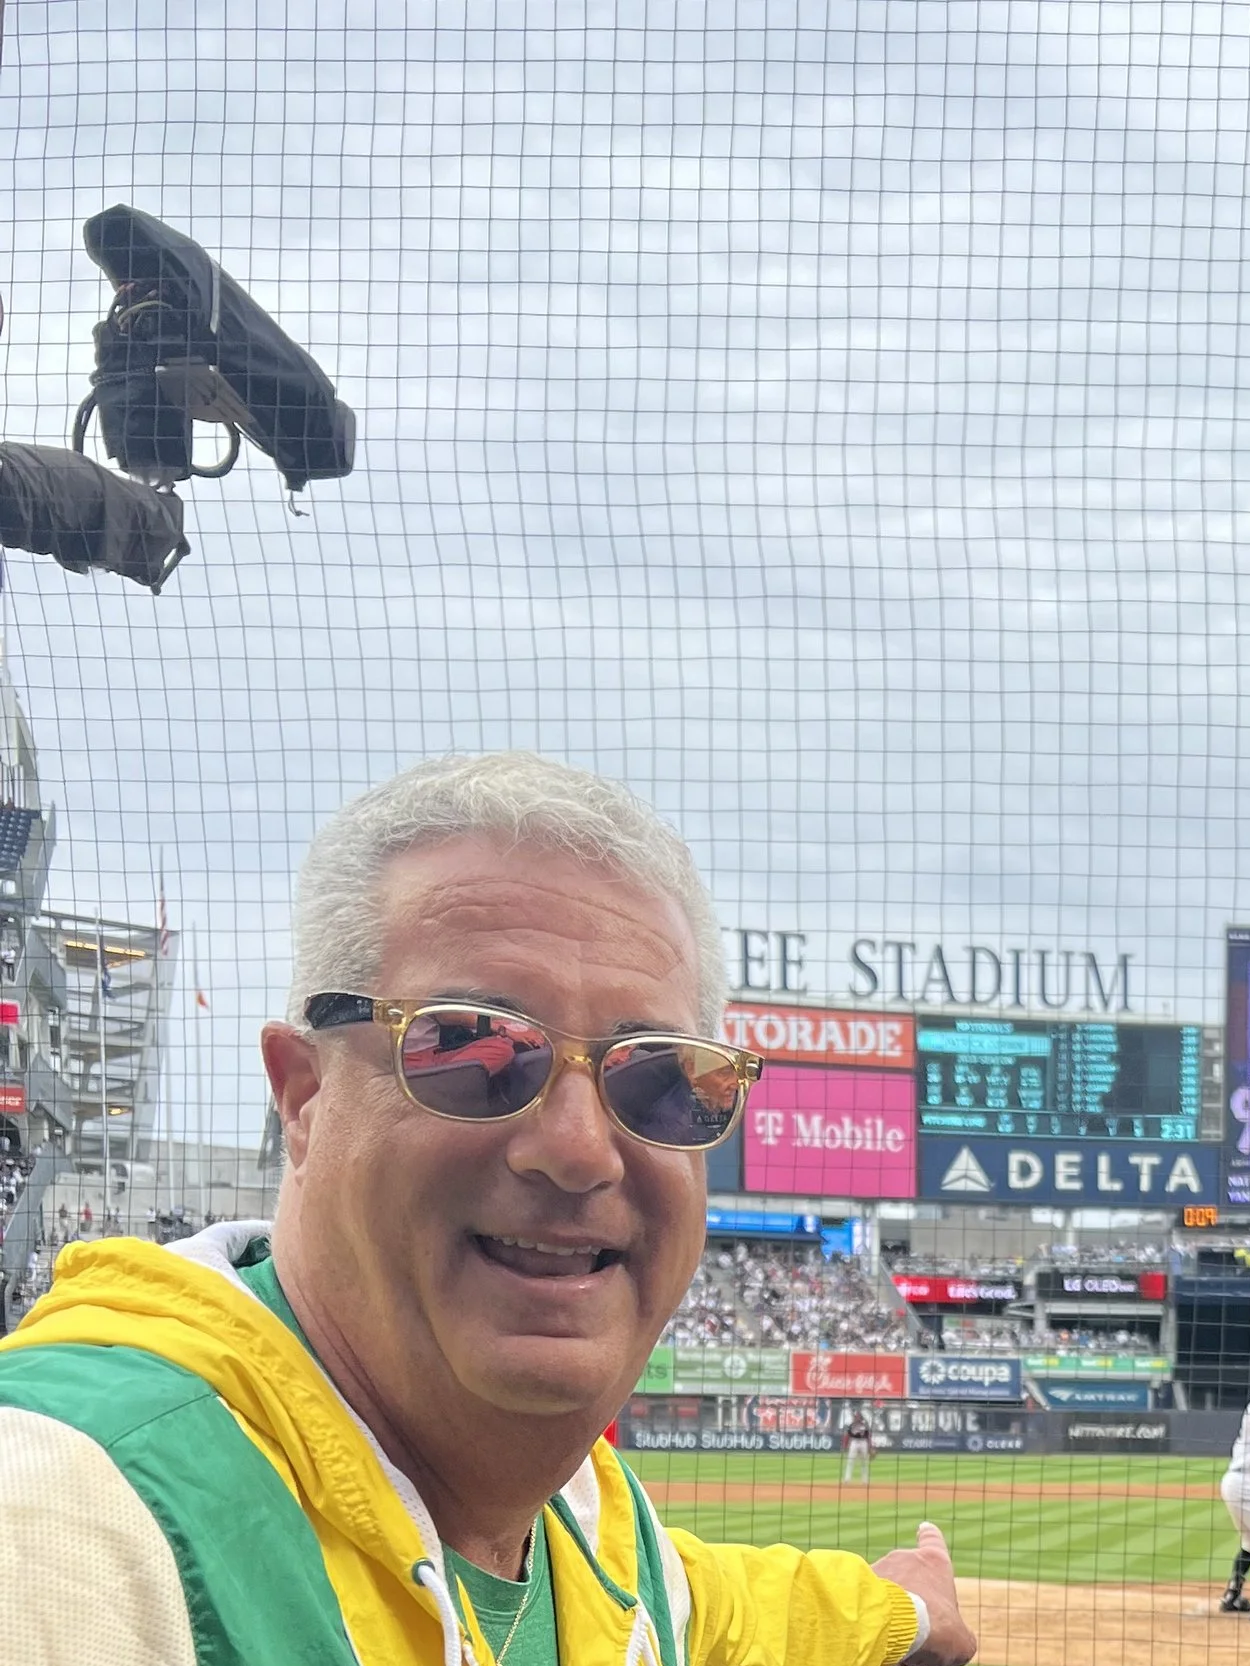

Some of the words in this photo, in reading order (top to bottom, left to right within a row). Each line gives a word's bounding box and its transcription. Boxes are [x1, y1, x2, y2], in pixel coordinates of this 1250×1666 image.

[721, 927, 807, 991] EE
[848, 938, 1136, 1012] STADIUM
[791, 1113, 906, 1152] Mobile
[1160, 1123, 1196, 1140] 2:31
[1008, 1150, 1202, 1193] DELTA
[1184, 1206, 1217, 1228] 0:09
[947, 1361, 1012, 1386] coupa
[635, 1433, 696, 1450] StubHub
[700, 1433, 763, 1450] StubHub
[768, 1433, 832, 1451] StubHub
